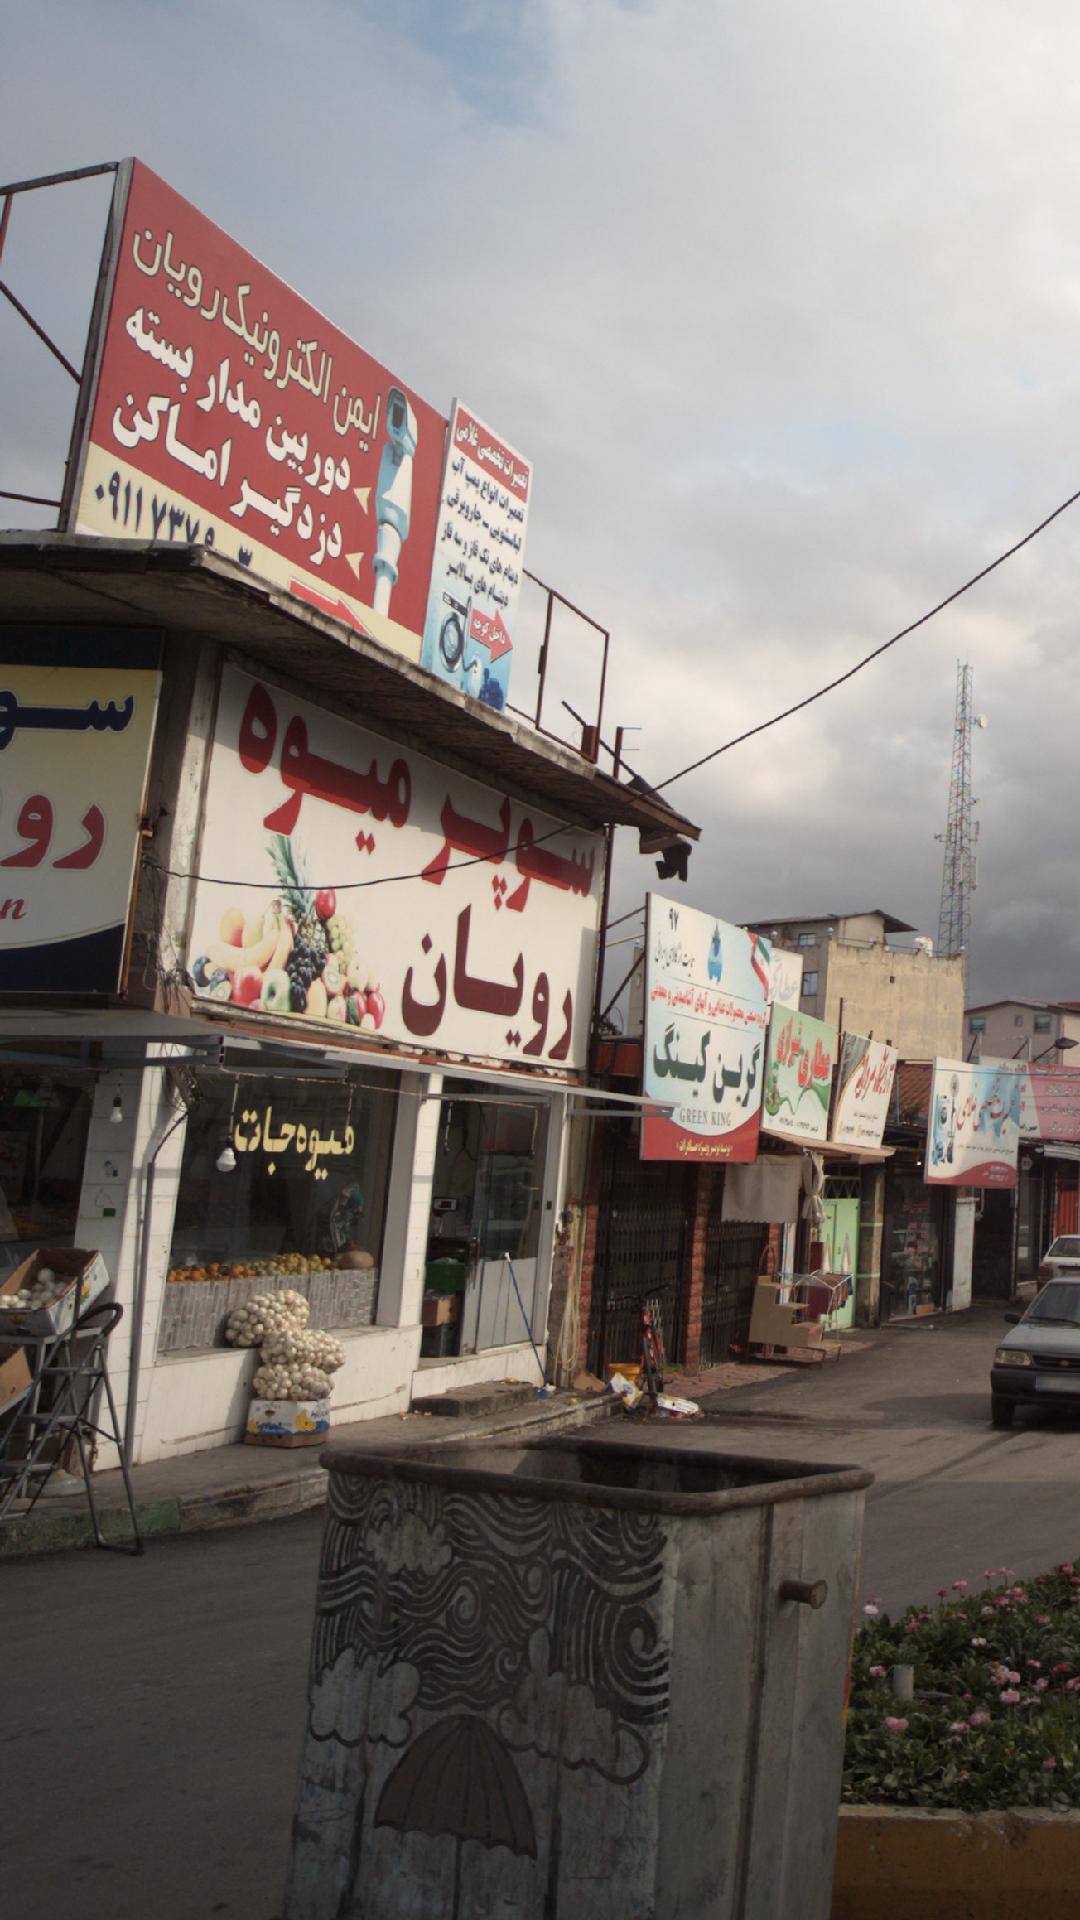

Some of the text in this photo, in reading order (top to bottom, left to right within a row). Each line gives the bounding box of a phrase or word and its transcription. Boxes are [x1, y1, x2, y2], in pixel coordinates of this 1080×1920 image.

[125, 307, 351, 496] دوربین مدار بسته
[132, 230, 381, 453] ایمن الکترونیک رویان
[112, 394, 343, 567] دزدگیر اماکن
[238, 681, 596, 913] سوپر میوه
[402, 904, 572, 1060] رویان
[679, 1106, 732, 1127] GREEN KING
